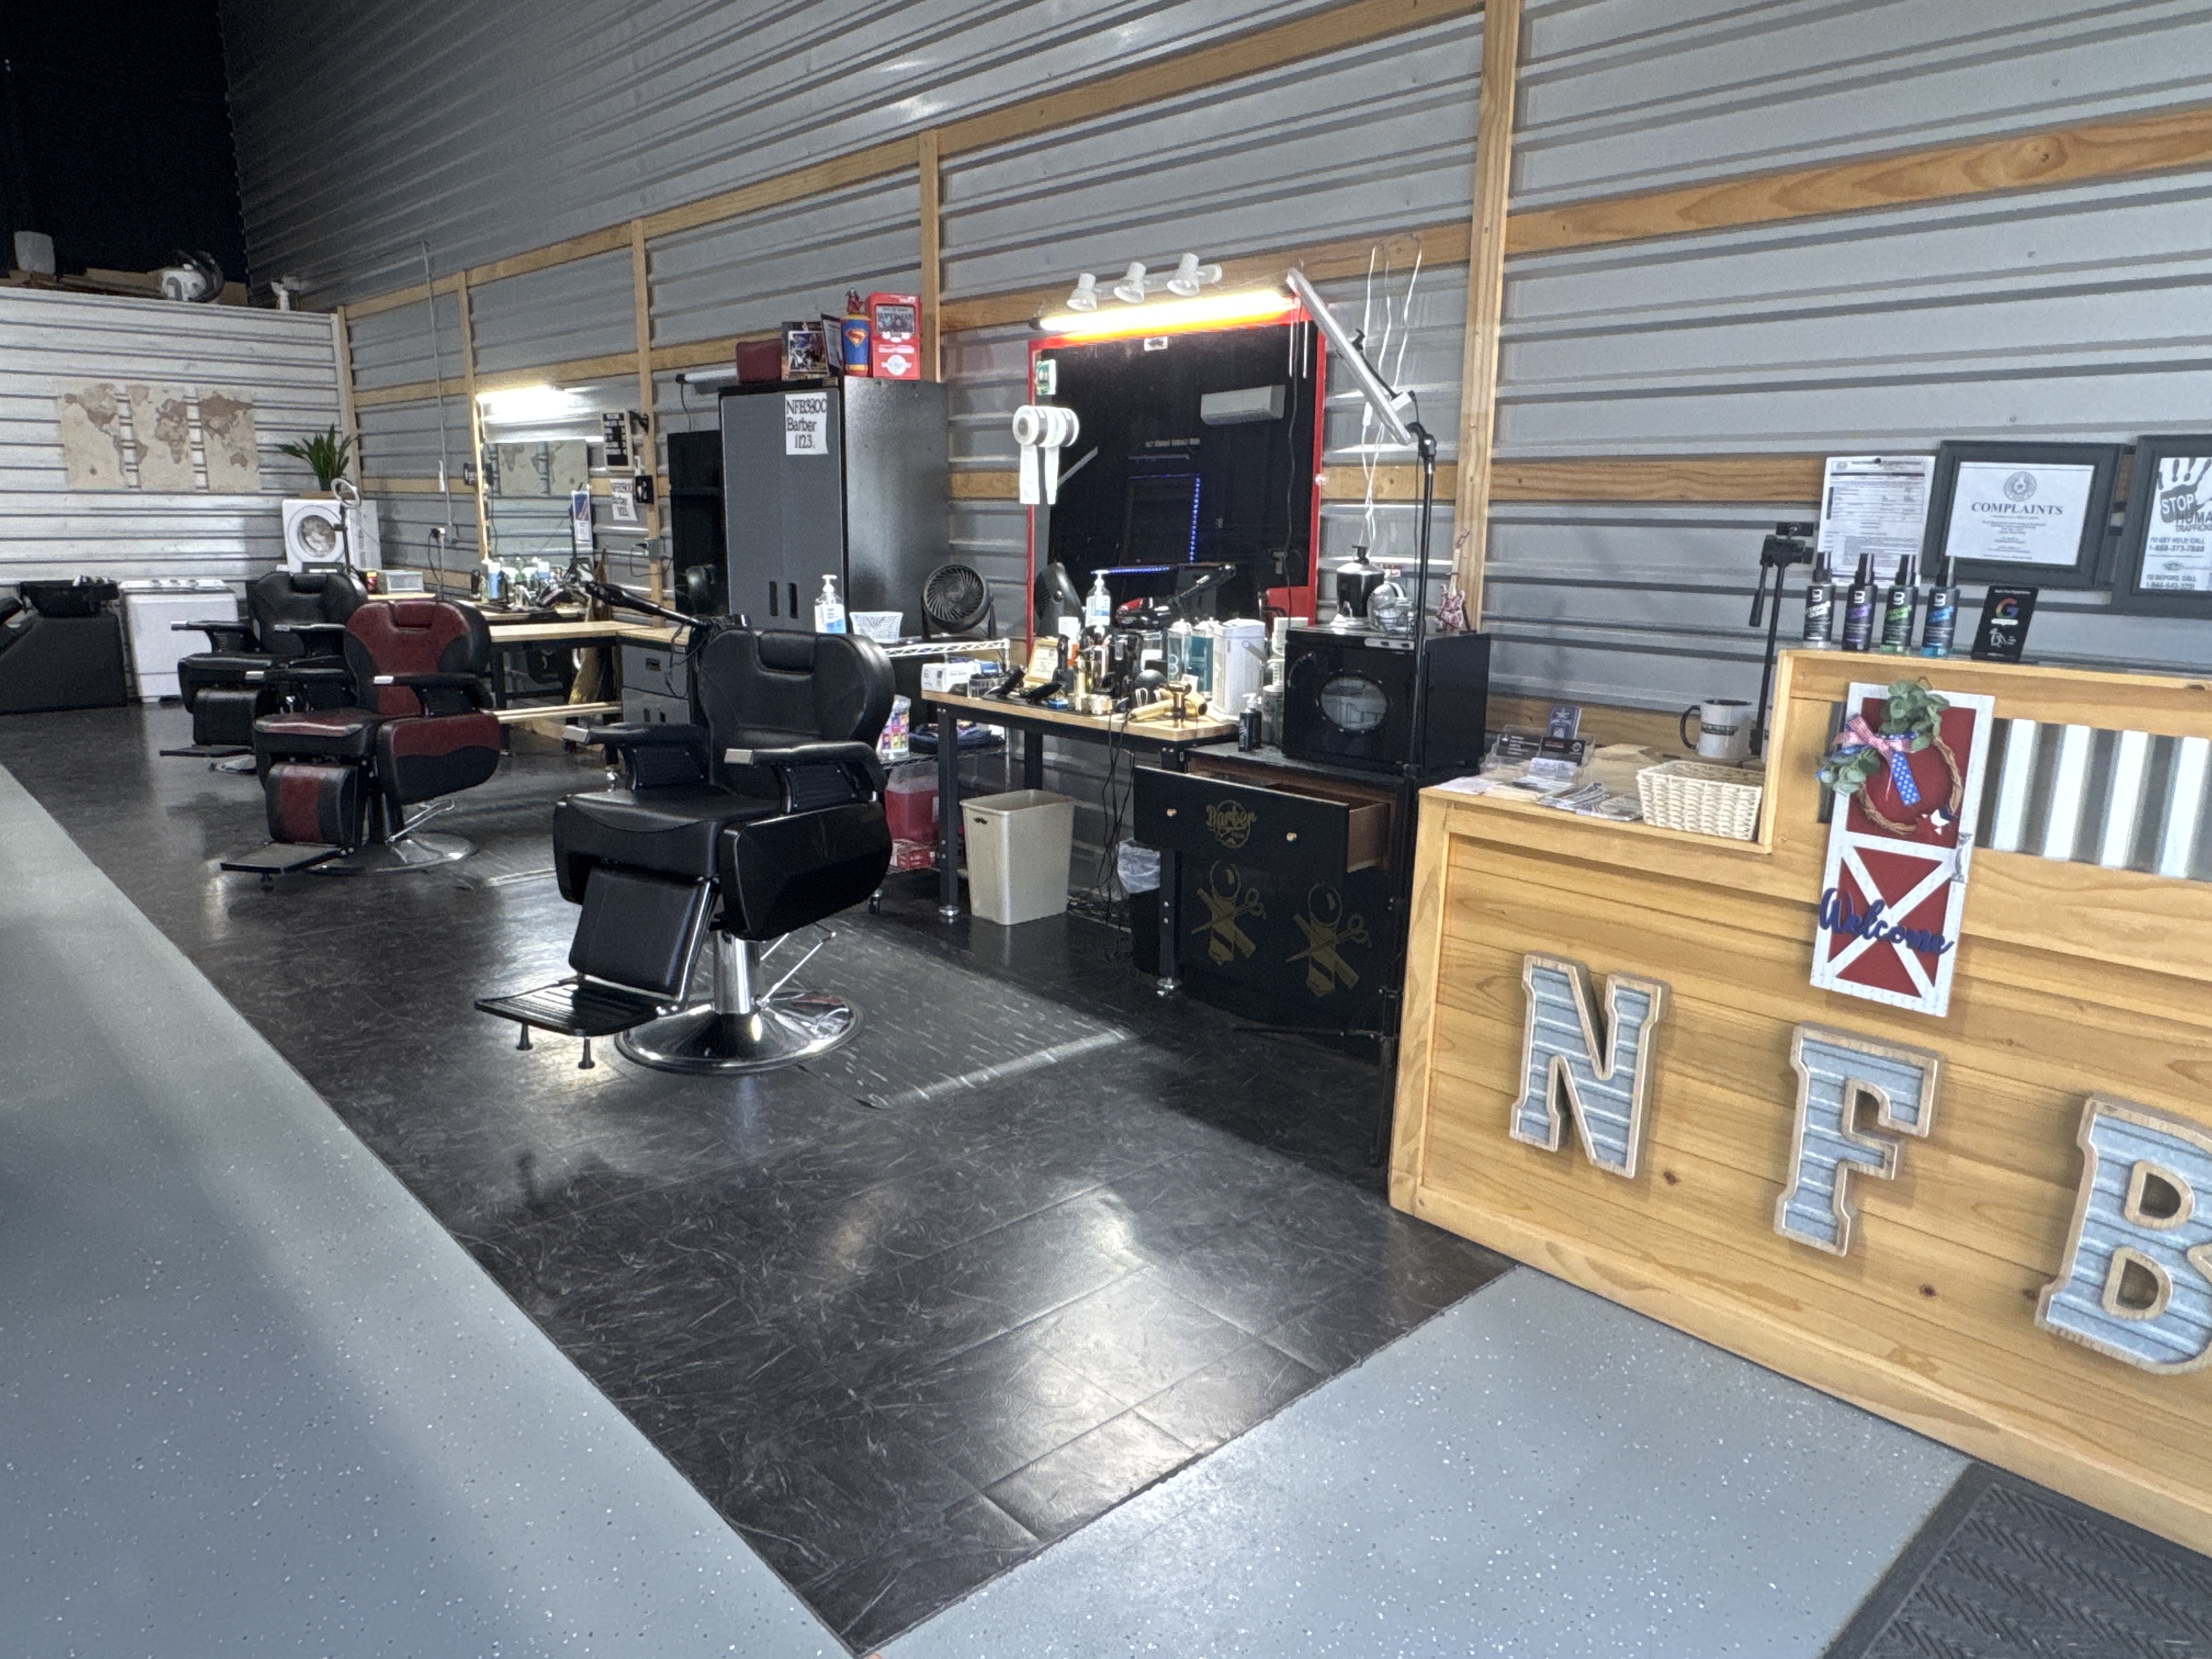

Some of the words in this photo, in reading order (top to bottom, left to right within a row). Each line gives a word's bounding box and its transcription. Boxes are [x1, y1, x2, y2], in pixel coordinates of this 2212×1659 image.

[787, 417, 817, 432] Barber
[1971, 501, 2063, 515] COMPLAINTS
[2162, 494, 2194, 515] STOP
[1819, 888, 1954, 956] Welcome
